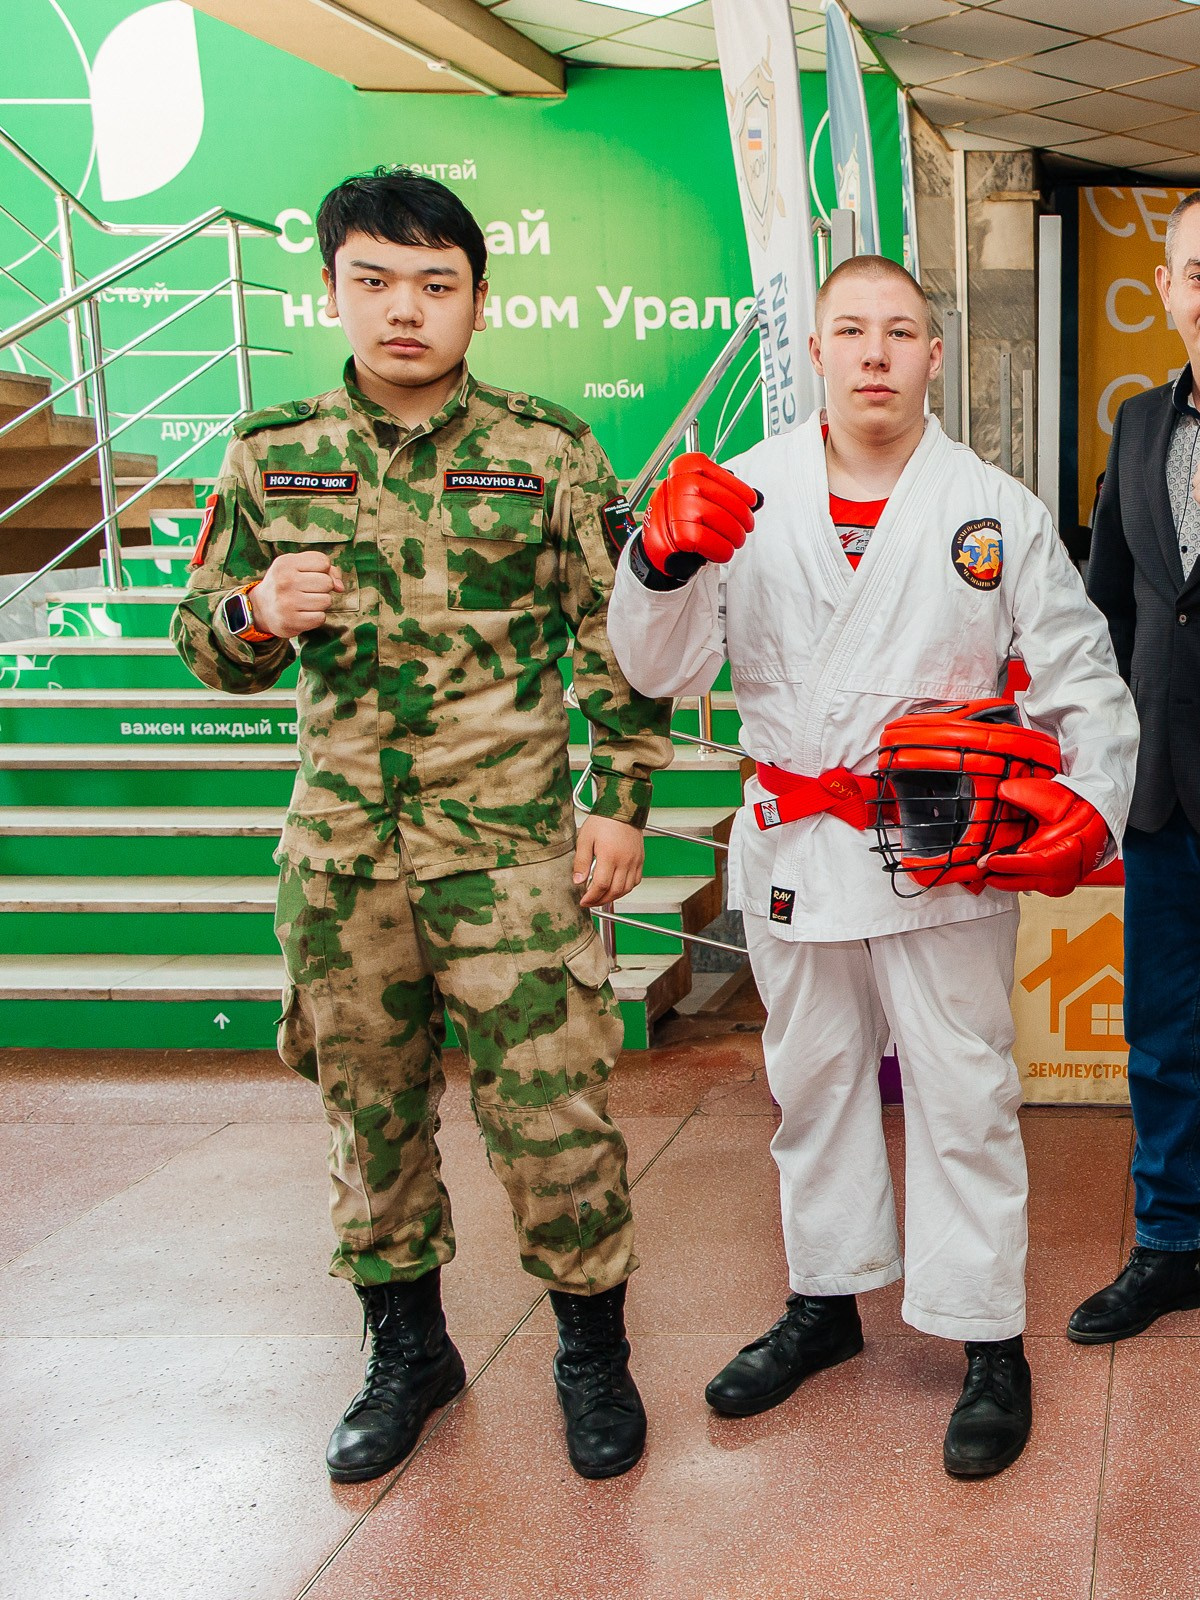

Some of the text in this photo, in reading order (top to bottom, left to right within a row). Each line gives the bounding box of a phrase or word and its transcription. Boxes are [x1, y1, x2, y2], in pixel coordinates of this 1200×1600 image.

[583, 379, 645, 399] люби
[269, 475, 348, 488] НОУ СПО ЧЮК
[451, 475, 538, 489] РОЗАХУНОВ А.А.
[120, 722, 185, 735] важен
[191, 718, 272, 738] каждый
[773, 890, 792, 902] RAY
